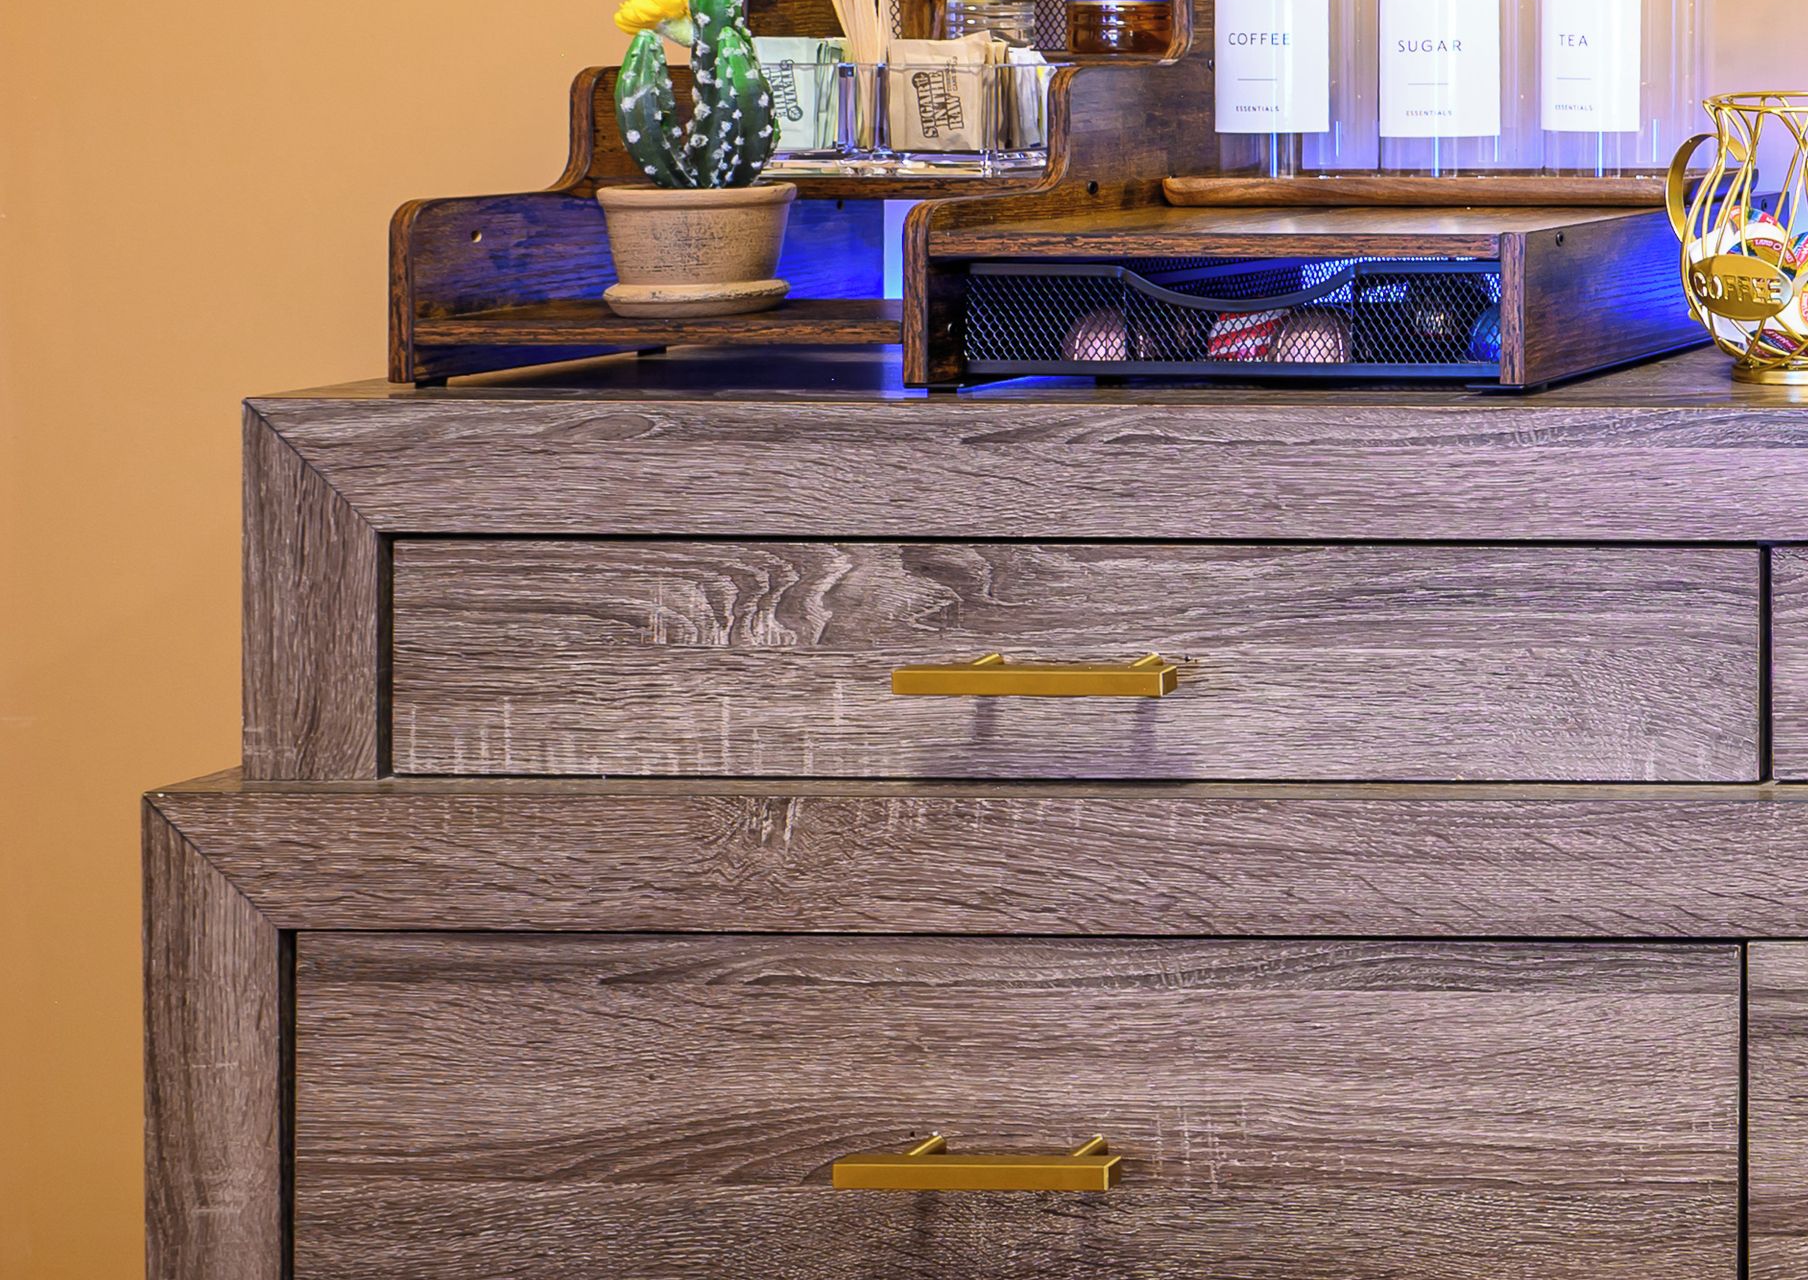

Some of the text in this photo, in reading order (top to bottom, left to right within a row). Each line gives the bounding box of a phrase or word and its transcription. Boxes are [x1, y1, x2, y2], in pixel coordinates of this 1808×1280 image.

[1228, 32, 1290, 46] COFFEE
[1398, 39, 1462, 53] SUGAR
[1559, 34, 1588, 47] TEA
[929, 71, 947, 106] THE
[916, 82, 939, 138] SUGAR
[934, 106, 950, 127] IN
[945, 94, 964, 130] RAW
[1694, 272, 1783, 305] COFFEE
